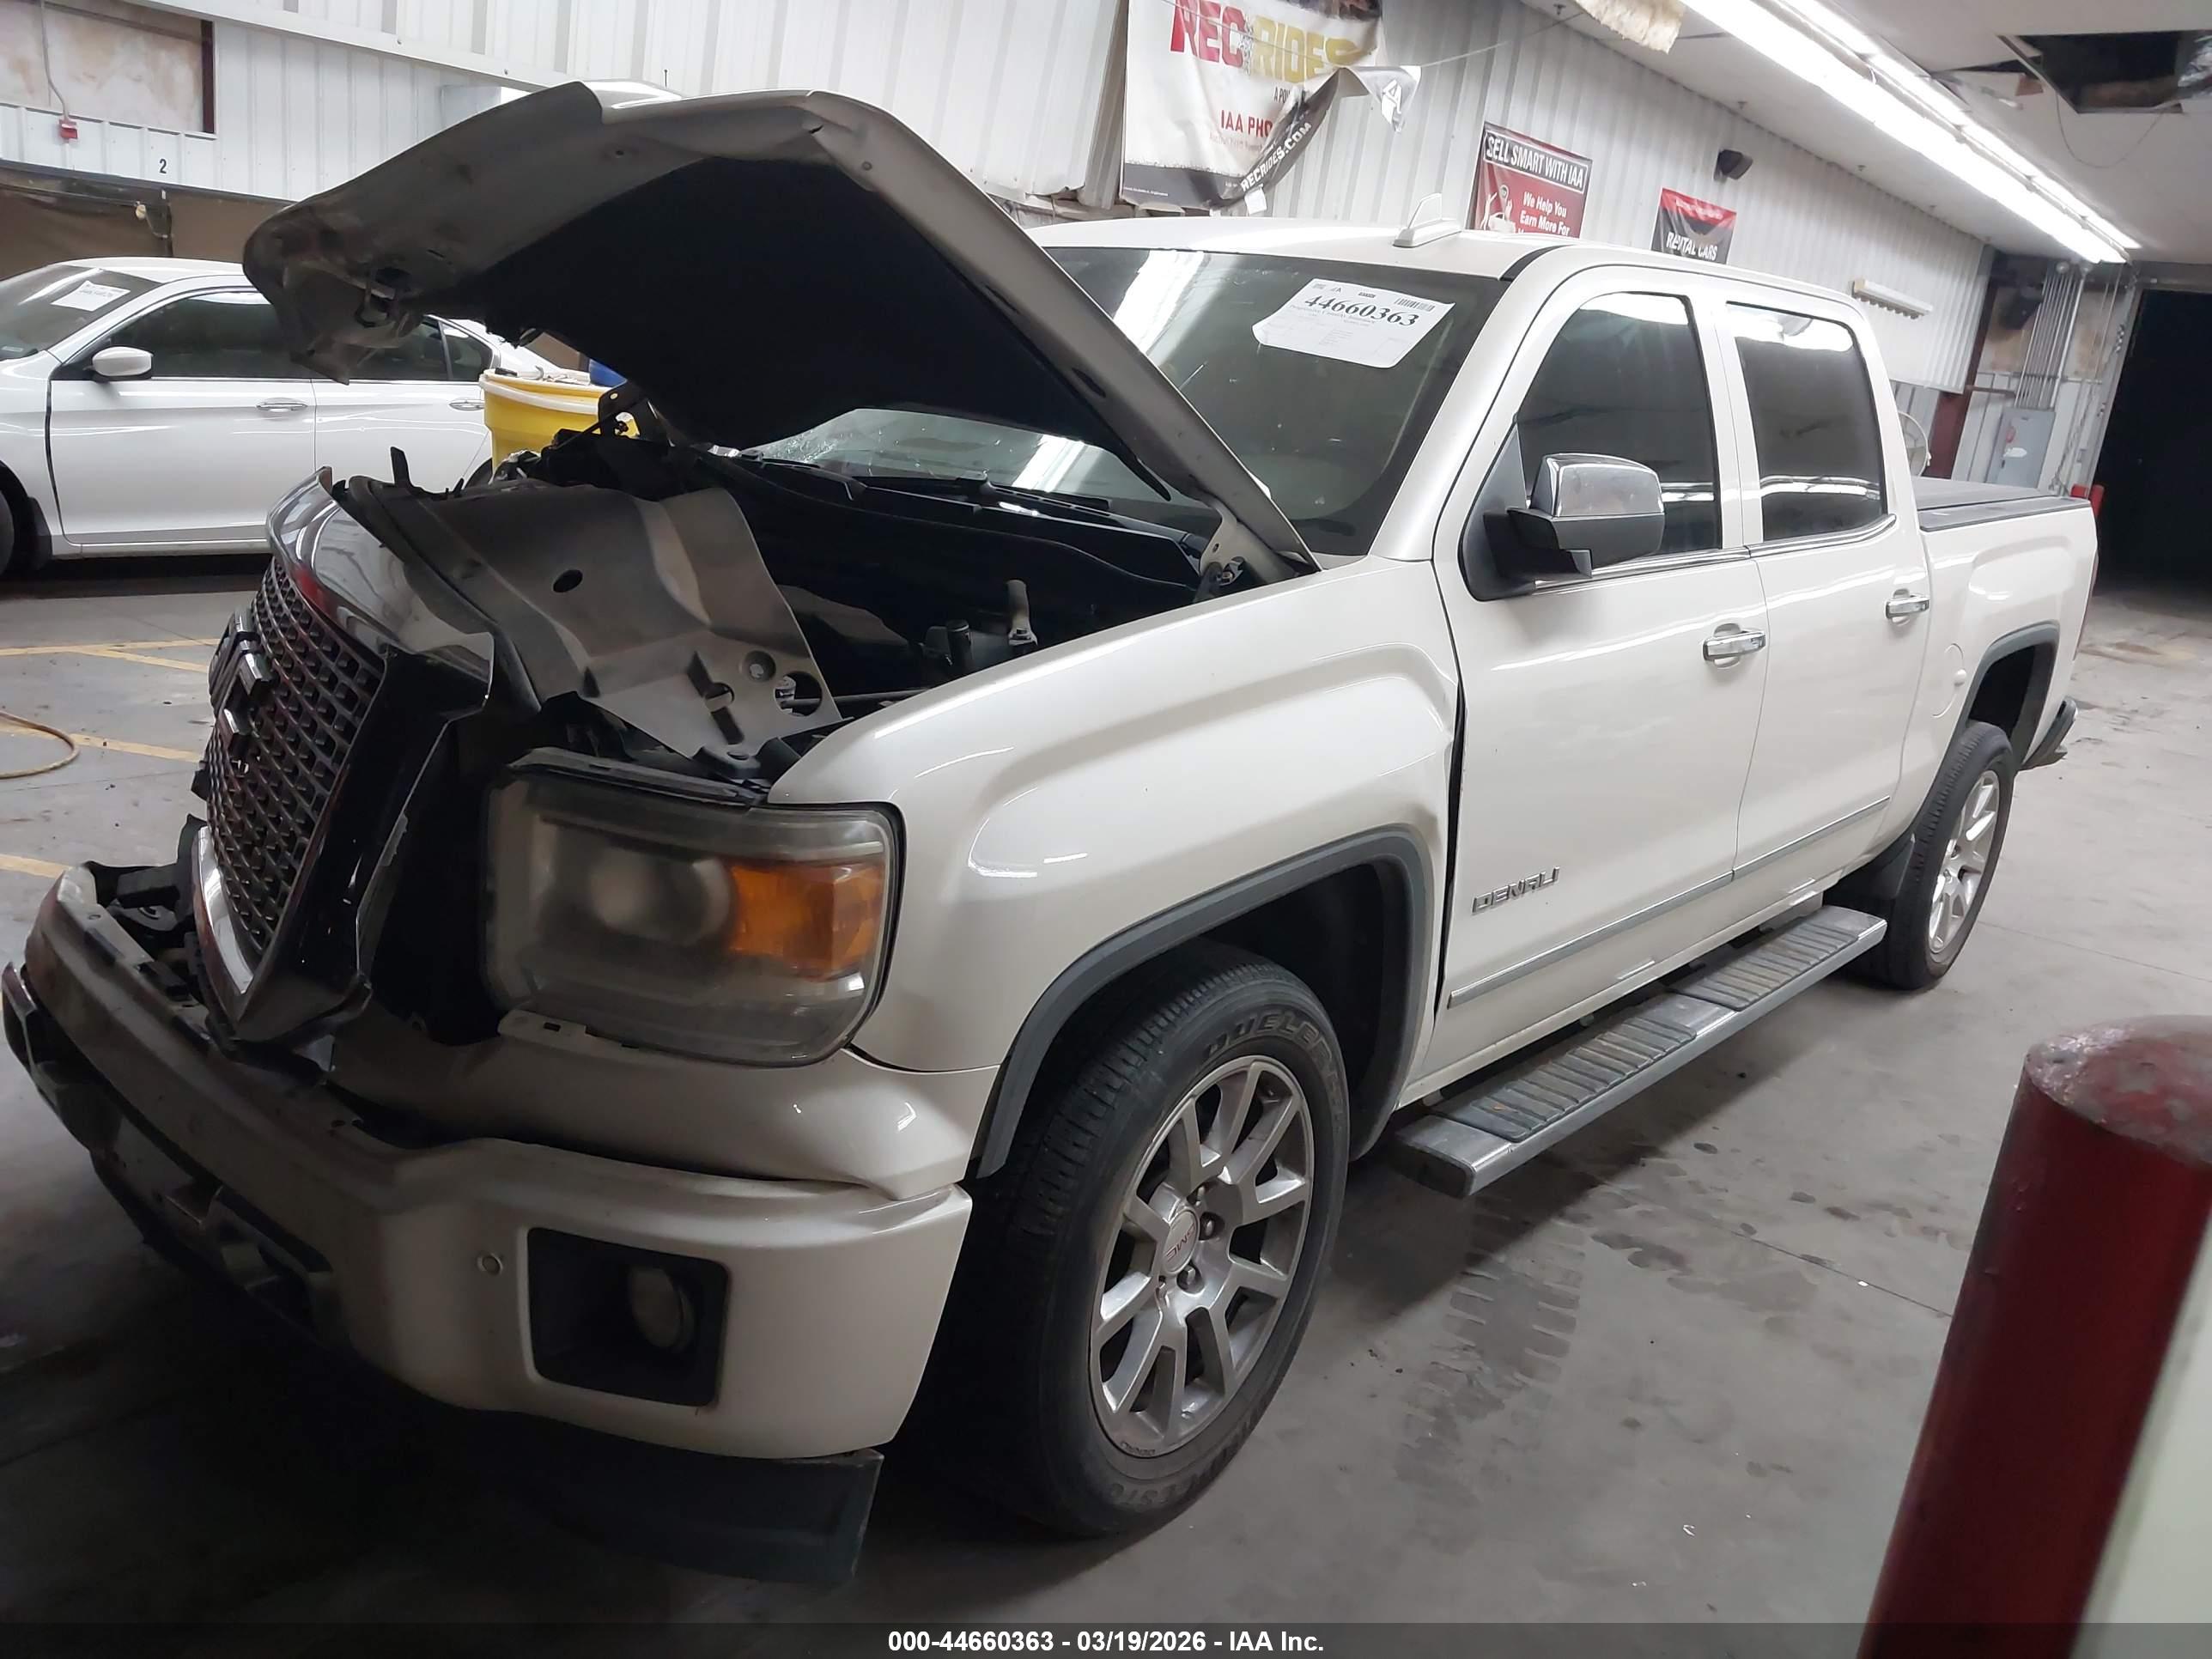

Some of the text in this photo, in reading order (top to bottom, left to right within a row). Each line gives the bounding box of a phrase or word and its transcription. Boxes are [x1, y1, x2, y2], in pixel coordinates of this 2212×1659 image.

[1221, 109, 1244, 133] IAA
[159, 158, 167, 174] 2
[1241, 122, 1312, 191] RECRIDES.COM
[1486, 136, 1584, 188] SELL SMART WITH IAA
[1523, 191, 1567, 218] We Help You
[1520, 210, 1571, 237] Earn More For
[1698, 244, 1718, 261] CARS
[1304, 295, 1419, 326] 44660363
[1472, 866, 1560, 915] DENALI
